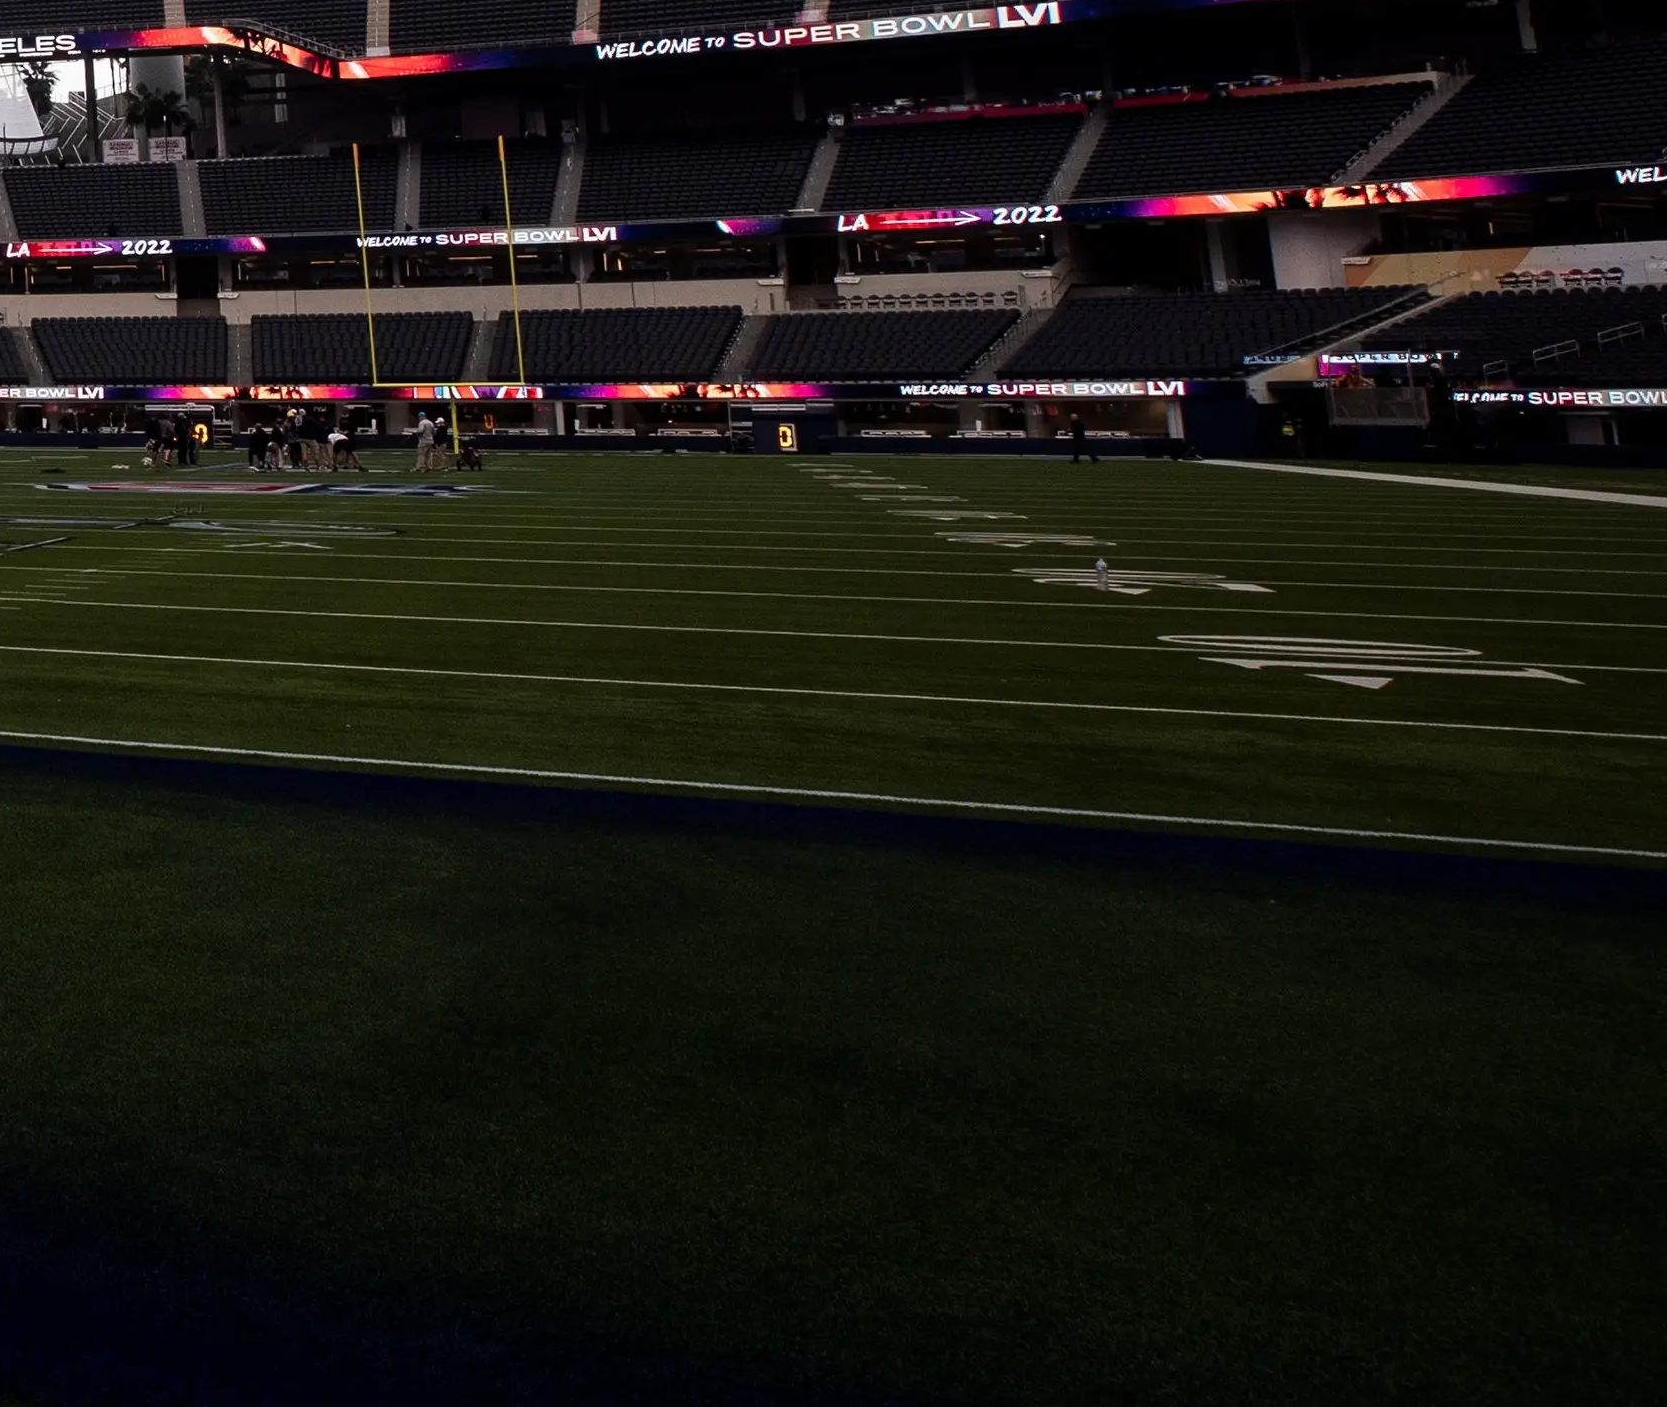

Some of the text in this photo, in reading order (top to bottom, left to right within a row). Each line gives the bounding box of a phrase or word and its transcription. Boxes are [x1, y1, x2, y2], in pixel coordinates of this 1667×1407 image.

[597, 38, 700, 60] WELCOME
[732, 22, 861, 48] SUPER
[871, 8, 991, 38] BOWL
[996, 2, 1061, 29] LVI
[837, 205, 1063, 231] LA 2022
[356, 235, 417, 247] WELCOME
[435, 232, 508, 245] SUPER
[513, 229, 579, 242] BOWL
[582, 226, 617, 242] LVI
[6, 239, 172, 258] LA 2022
[25, 387, 76, 398] BOWL
[77, 387, 104, 399] LVI
[900, 385, 968, 395] WELCOME
[987, 383, 1068, 395] SUPER
[1073, 383, 1145, 395] BOWL
[1147, 381, 1186, 395] LVI
[1528, 391, 1604, 405] SUPER
